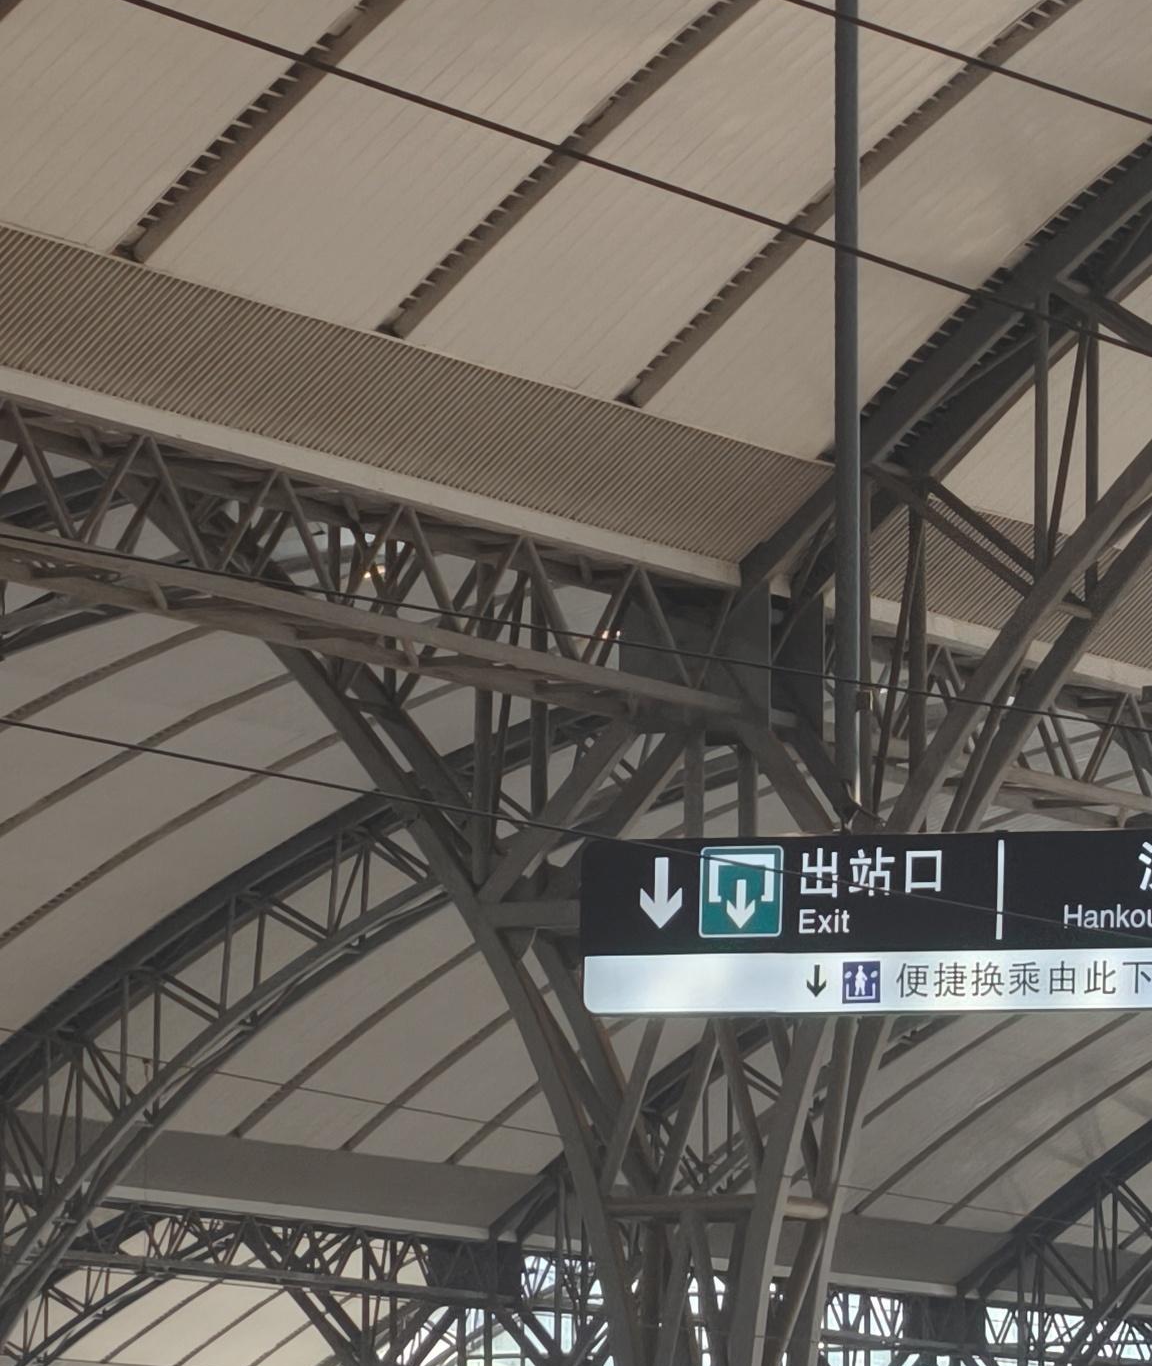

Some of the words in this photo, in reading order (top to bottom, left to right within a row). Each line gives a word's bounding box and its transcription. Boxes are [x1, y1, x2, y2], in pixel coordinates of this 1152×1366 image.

[800, 847, 944, 896] 出站口
[799, 909, 850, 935] Exit
